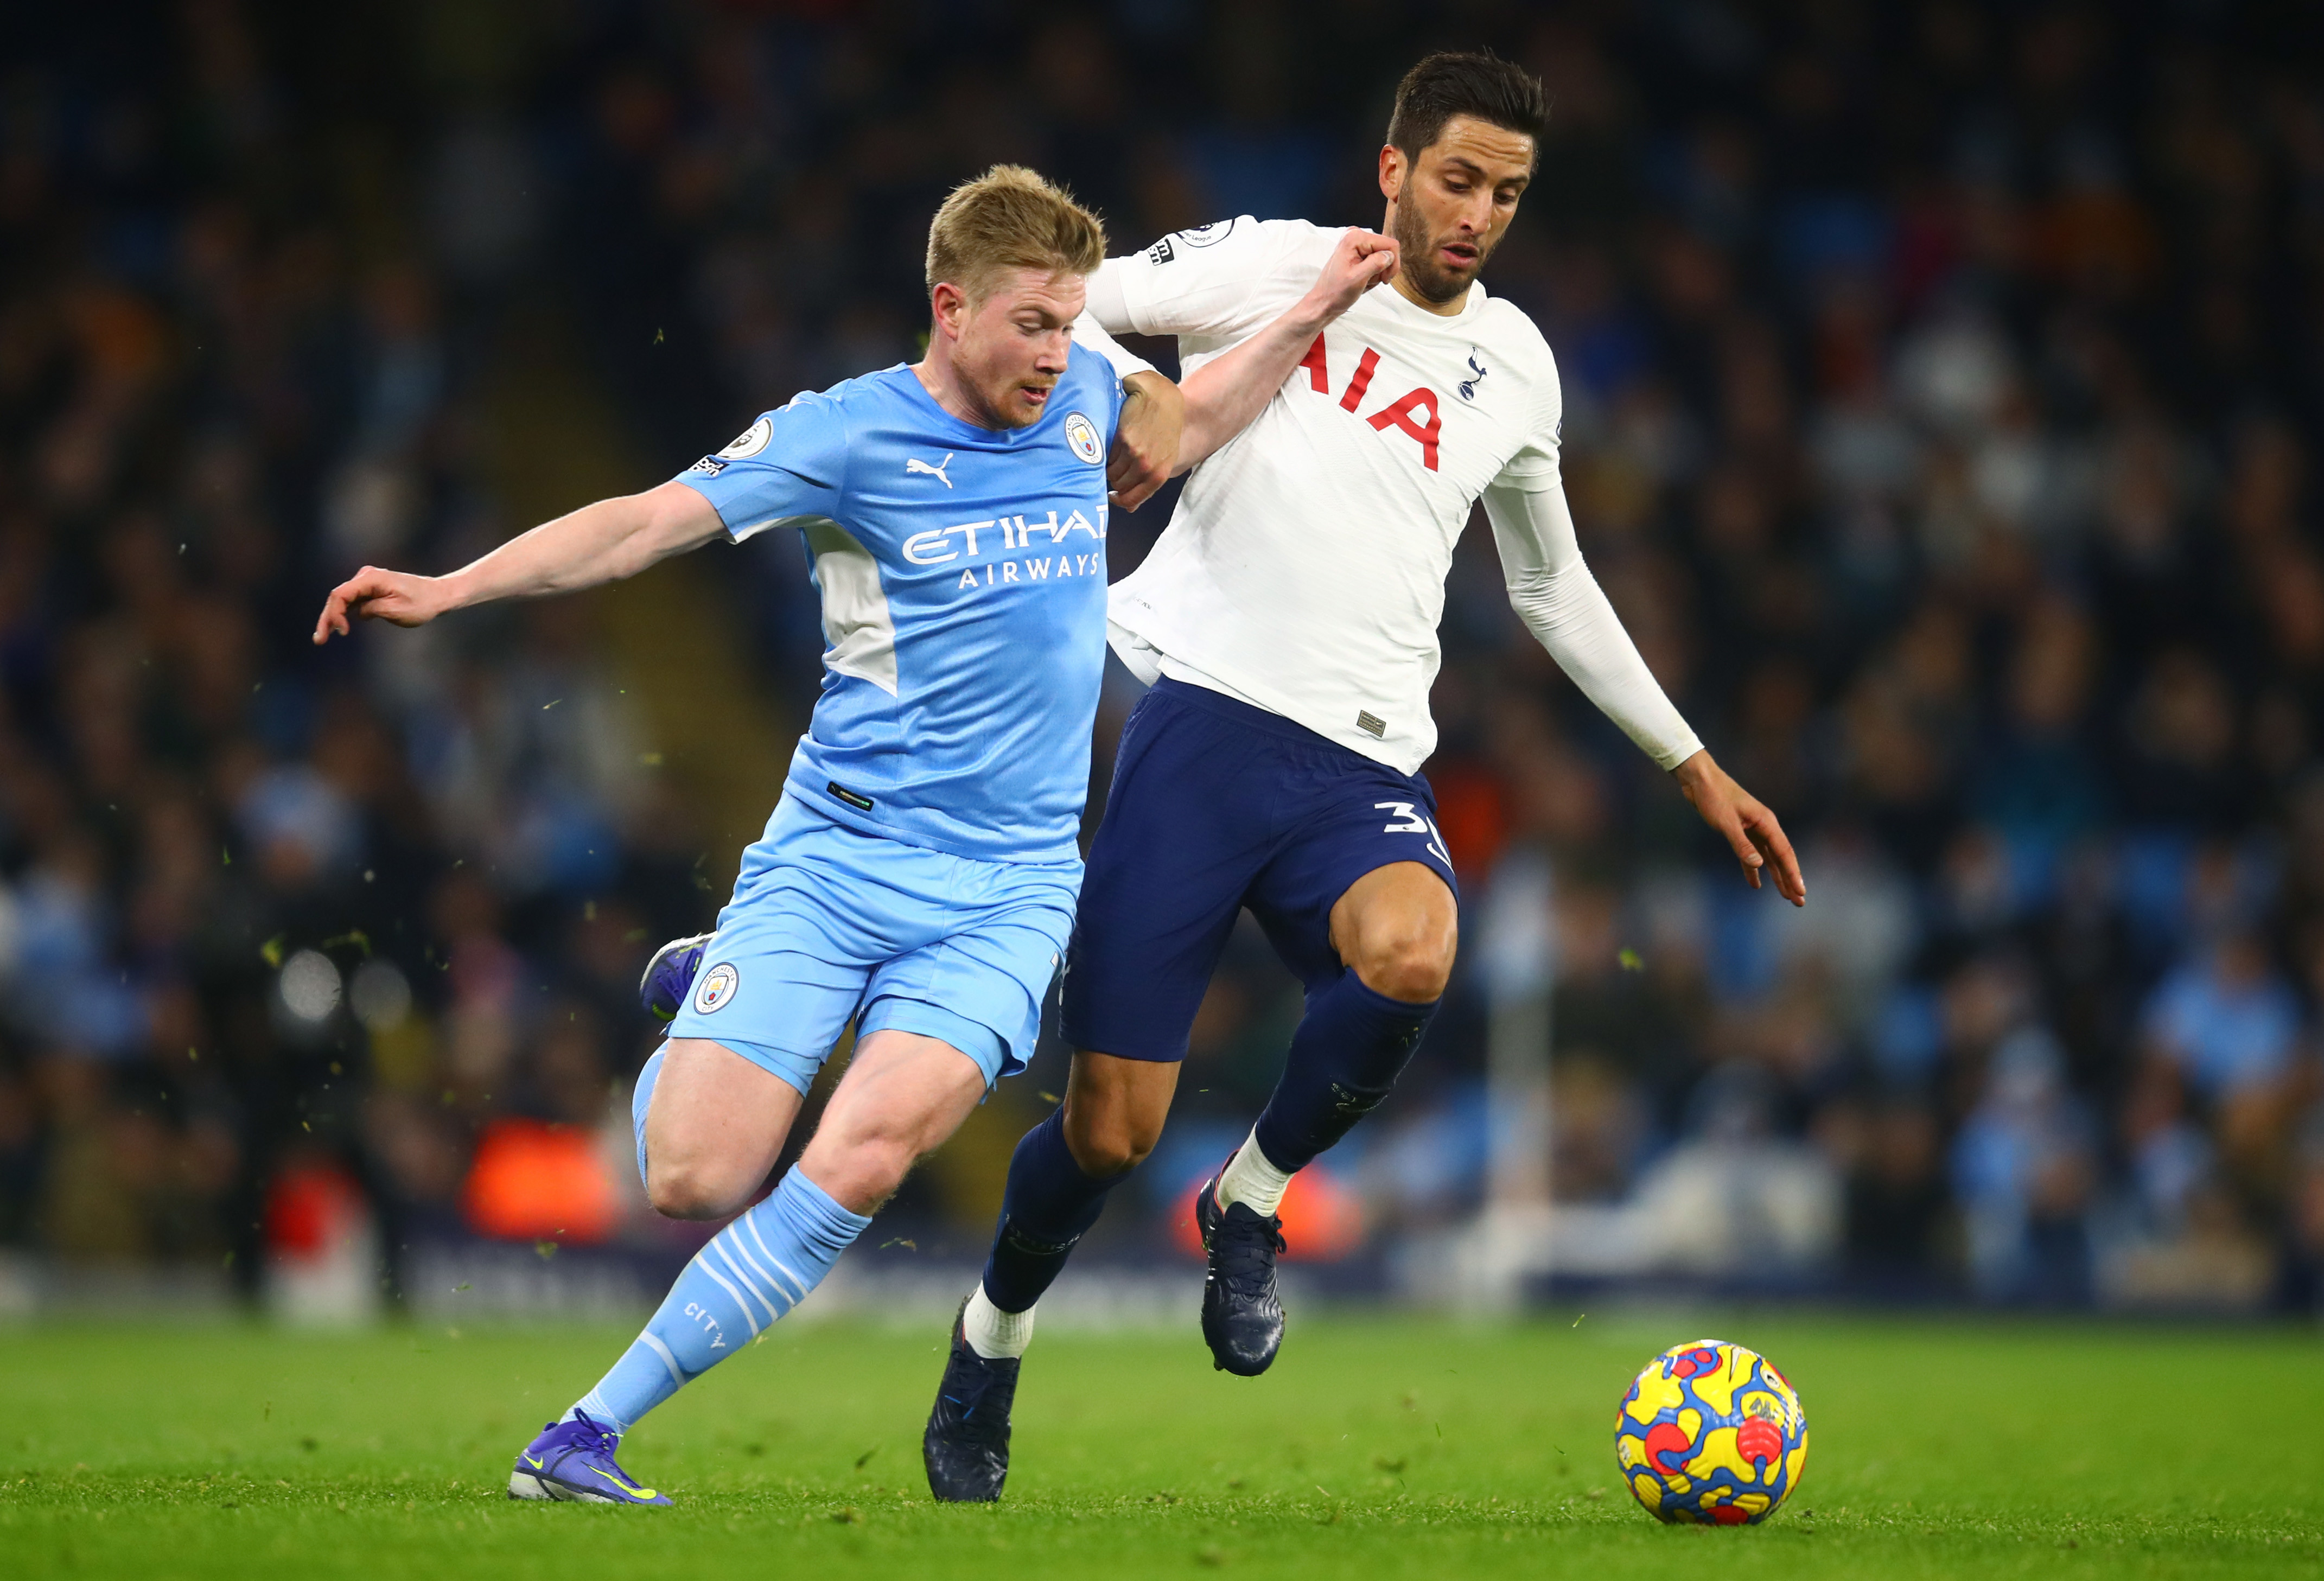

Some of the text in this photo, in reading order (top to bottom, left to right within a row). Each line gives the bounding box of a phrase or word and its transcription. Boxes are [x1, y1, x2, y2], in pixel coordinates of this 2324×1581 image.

[1067, 416, 1091, 437] MANCHESTER
[958, 552, 1099, 589] AIRWAYS
[704, 967, 735, 984] MANCHESTER
[684, 1302, 726, 1349] CITY
